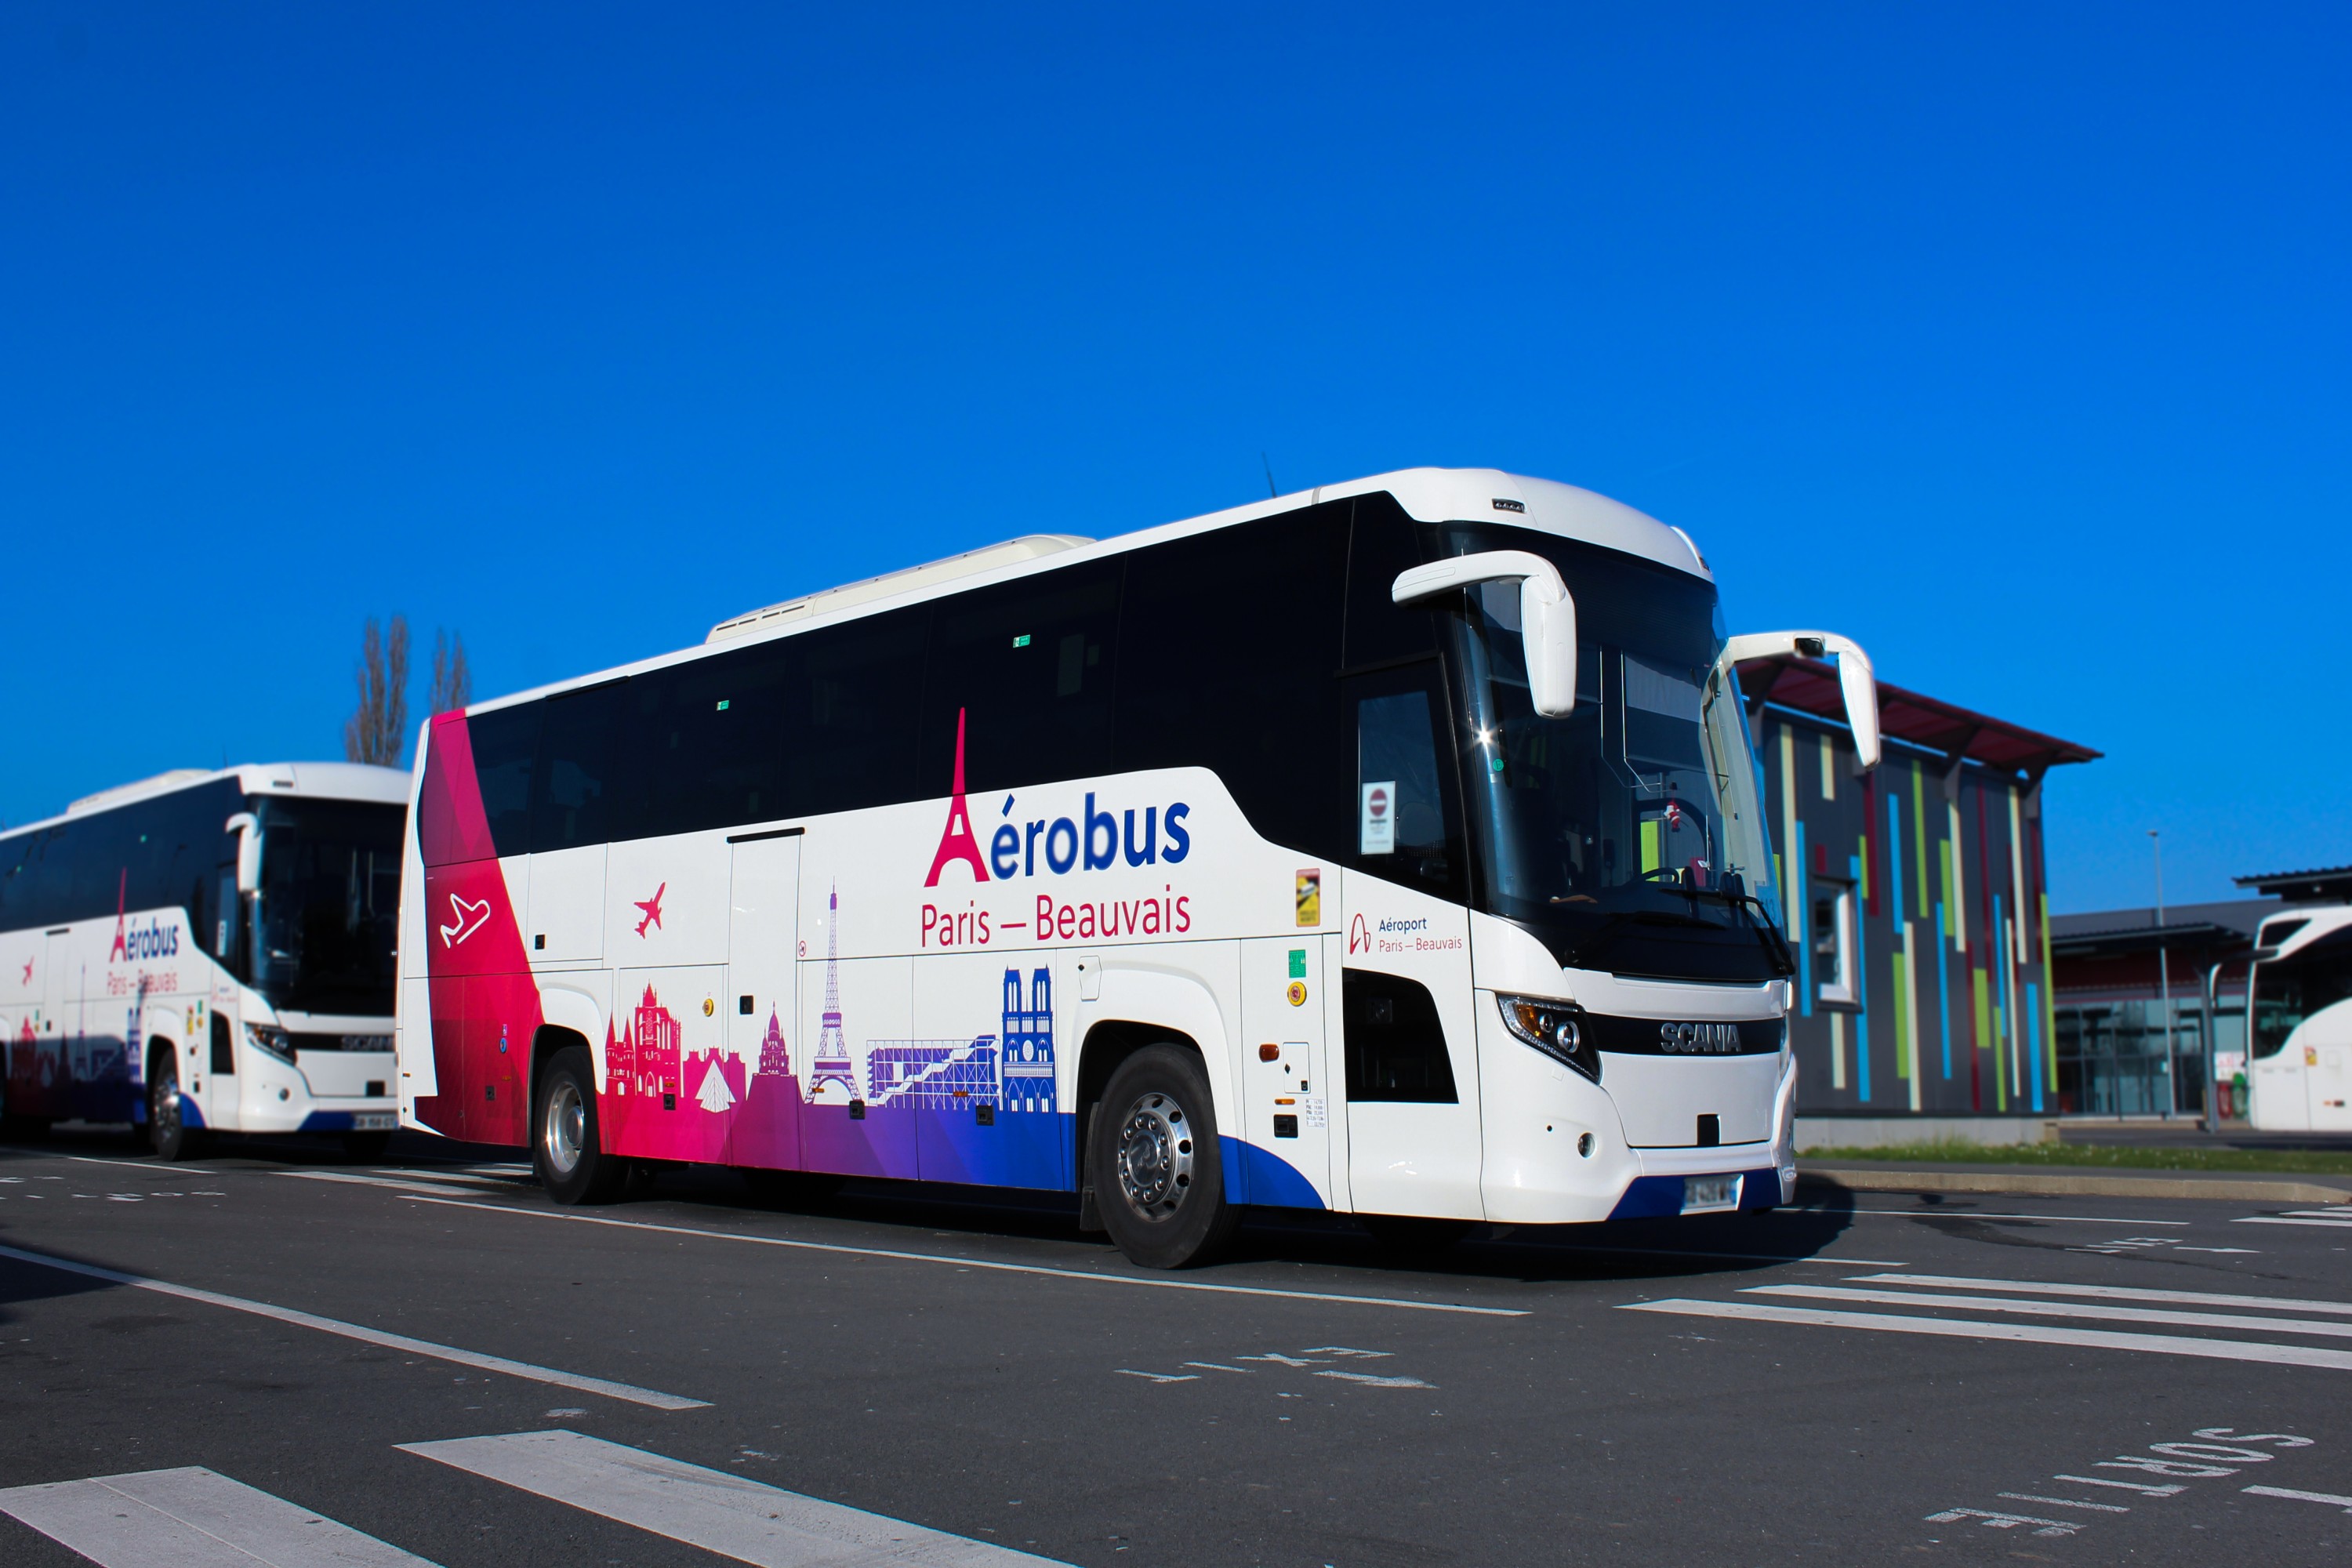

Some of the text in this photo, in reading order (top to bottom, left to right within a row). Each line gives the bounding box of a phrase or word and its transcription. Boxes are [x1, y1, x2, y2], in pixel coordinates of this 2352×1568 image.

[924, 706, 1191, 887] Aérobus
[109, 867, 180, 964] Aérobus
[921, 900, 991, 948] Paris
[1036, 884, 1191, 941] Beauvais
[1378, 916, 1428, 935] Aéroport
[1378, 938, 1403, 953] Paris
[1416, 935, 1463, 952] Beauvais
[107, 971, 127, 996] Paris
[341, 1034, 396, 1051] SCAN
[1660, 1022, 1742, 1053] SCANIA
[1922, 1427, 2315, 1537] SORTIE
